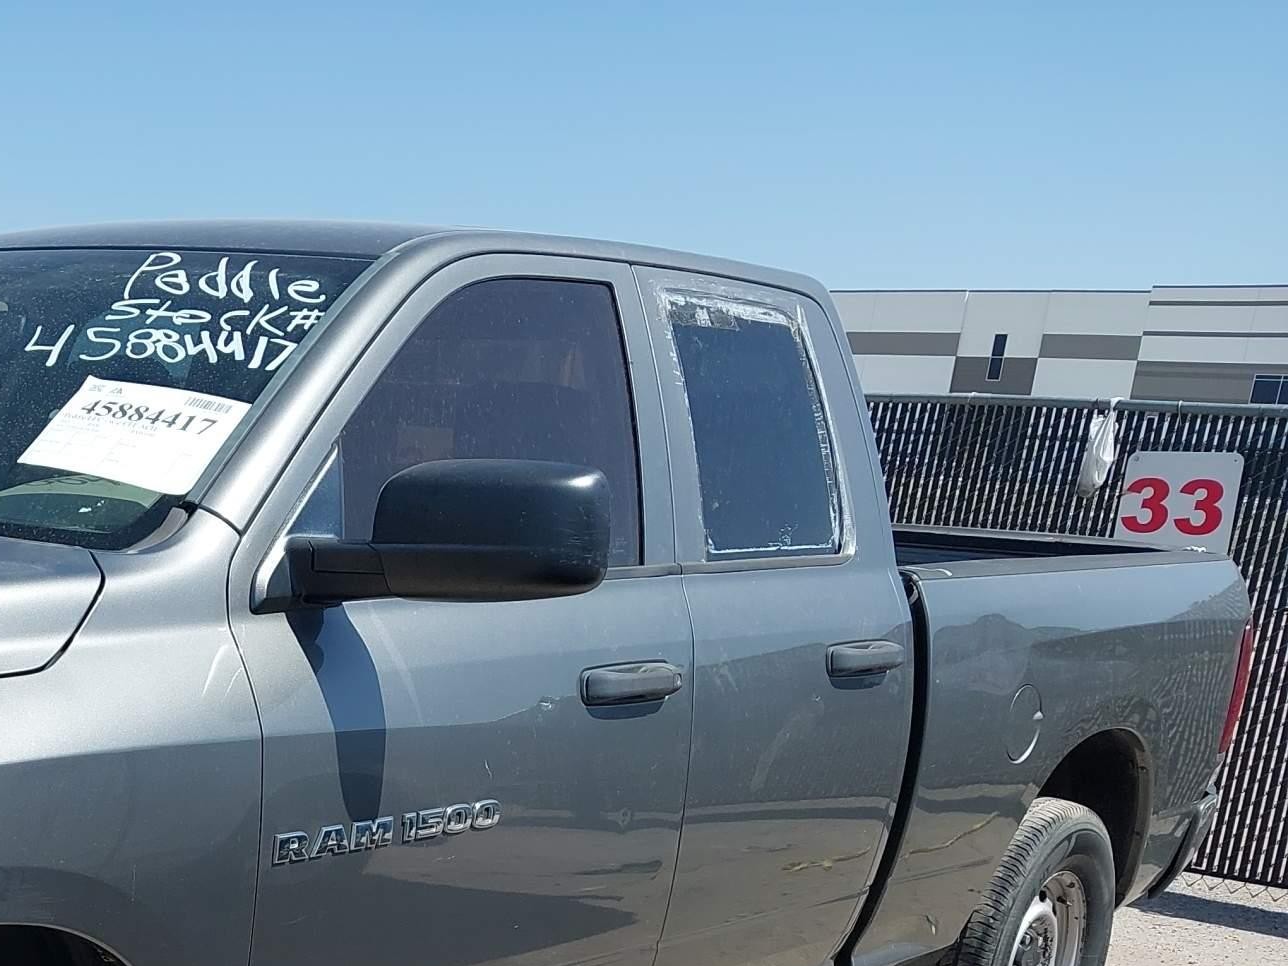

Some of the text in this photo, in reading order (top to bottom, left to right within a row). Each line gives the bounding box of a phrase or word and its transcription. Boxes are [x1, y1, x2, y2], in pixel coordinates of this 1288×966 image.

[124, 252, 326, 303] Paddle
[24, 324, 298, 371] 45884417
[81, 399, 219, 435] 45884417
[1120, 477, 1224, 536] 33
[272, 799, 503, 867] RAM 1500
